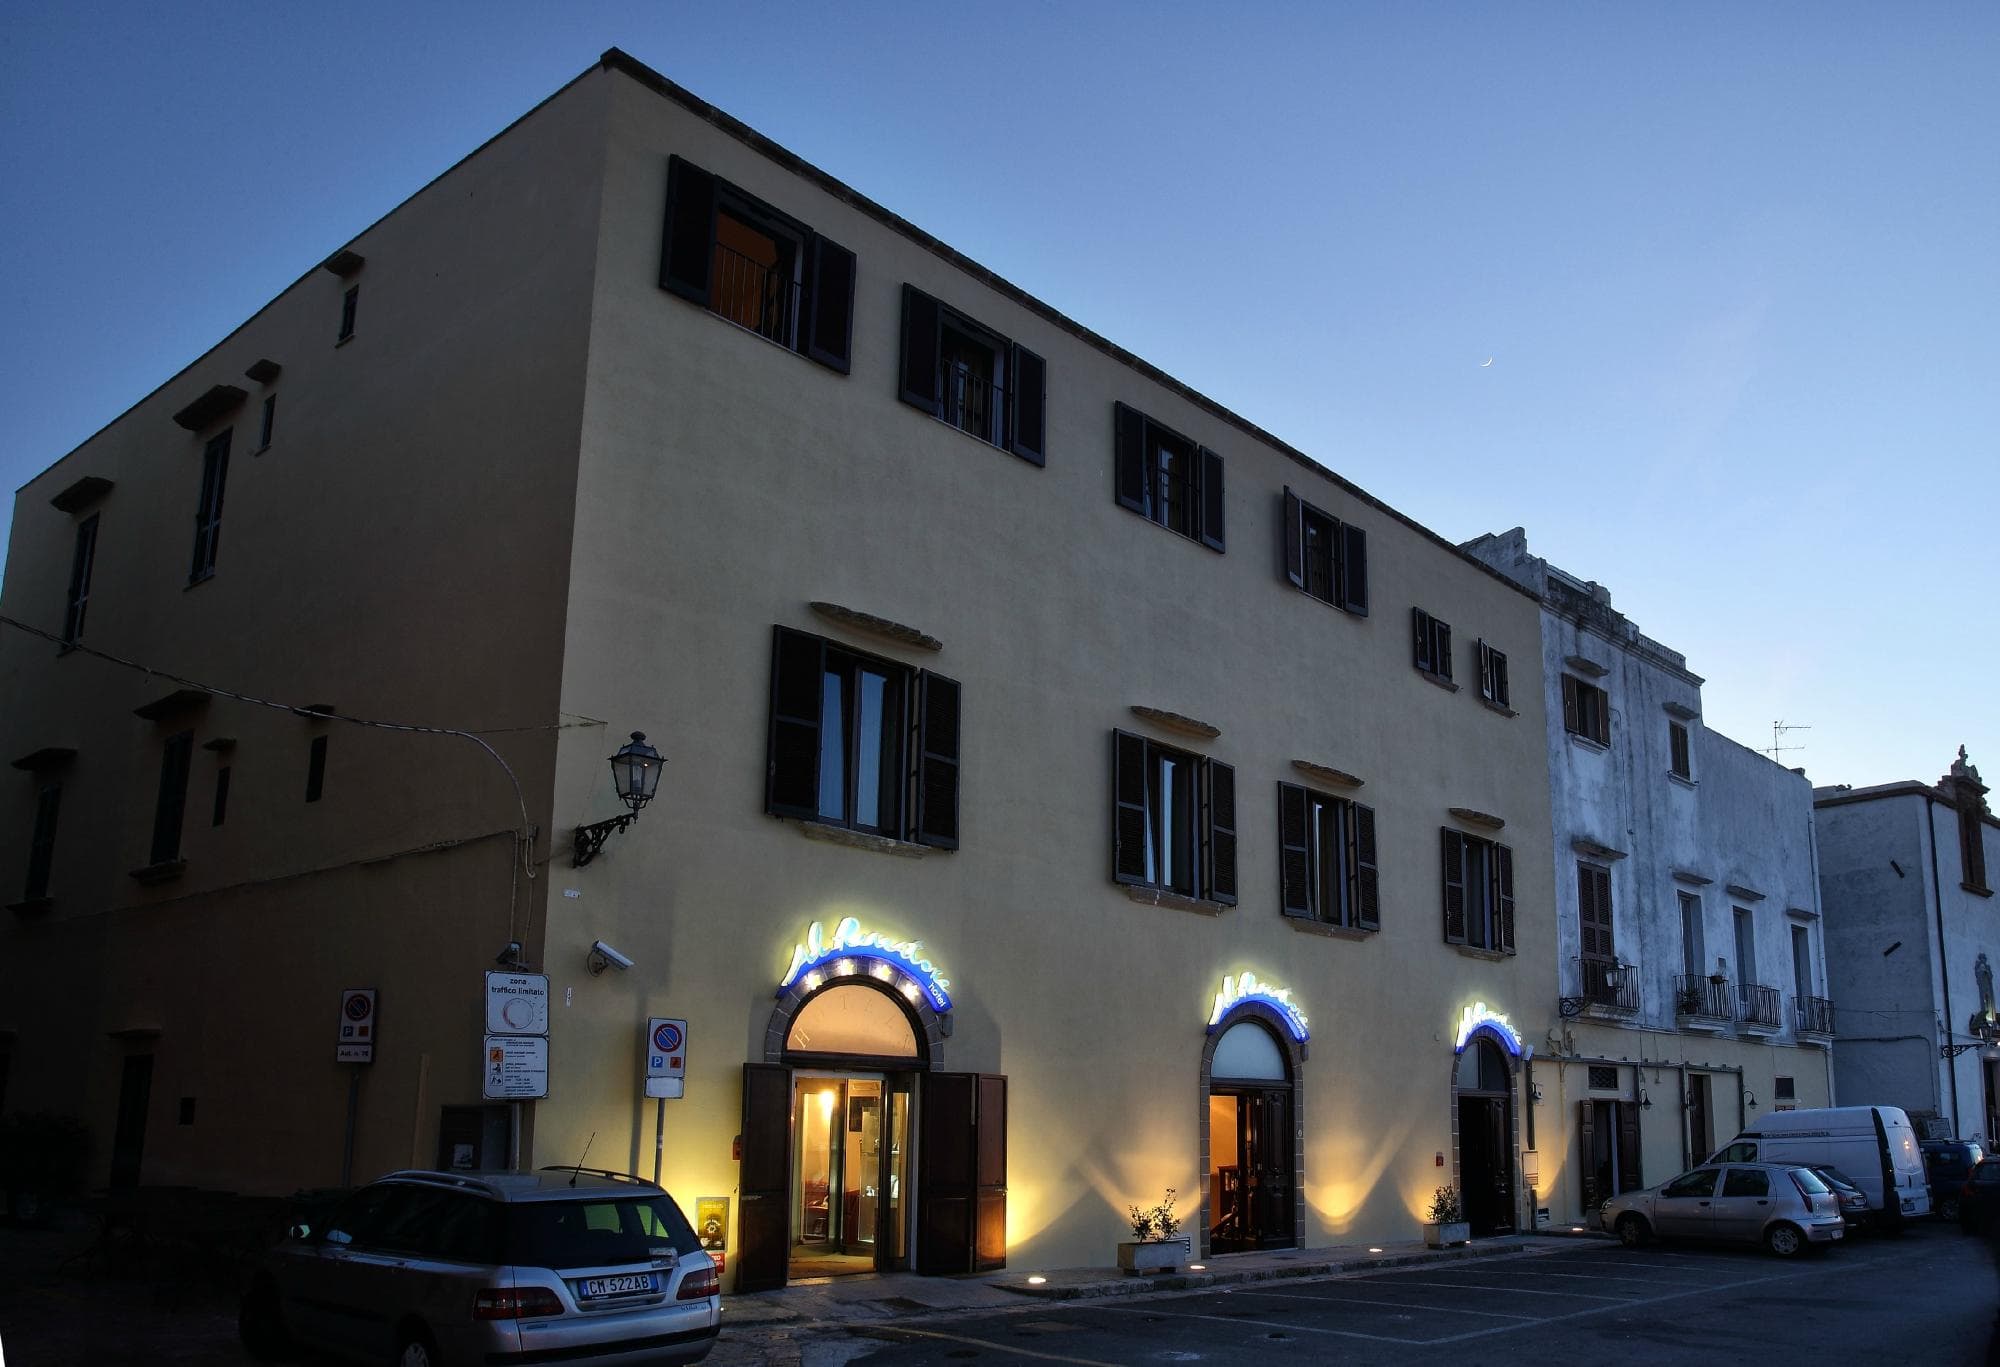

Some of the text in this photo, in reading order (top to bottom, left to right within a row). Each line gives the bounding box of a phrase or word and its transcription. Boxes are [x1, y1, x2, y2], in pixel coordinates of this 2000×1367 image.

[509, 977, 527, 985] zona
[491, 985, 545, 996] traffico limitato
[927, 982, 947, 1009] hotel
[589, 1275, 649, 1294] CM 522AB
